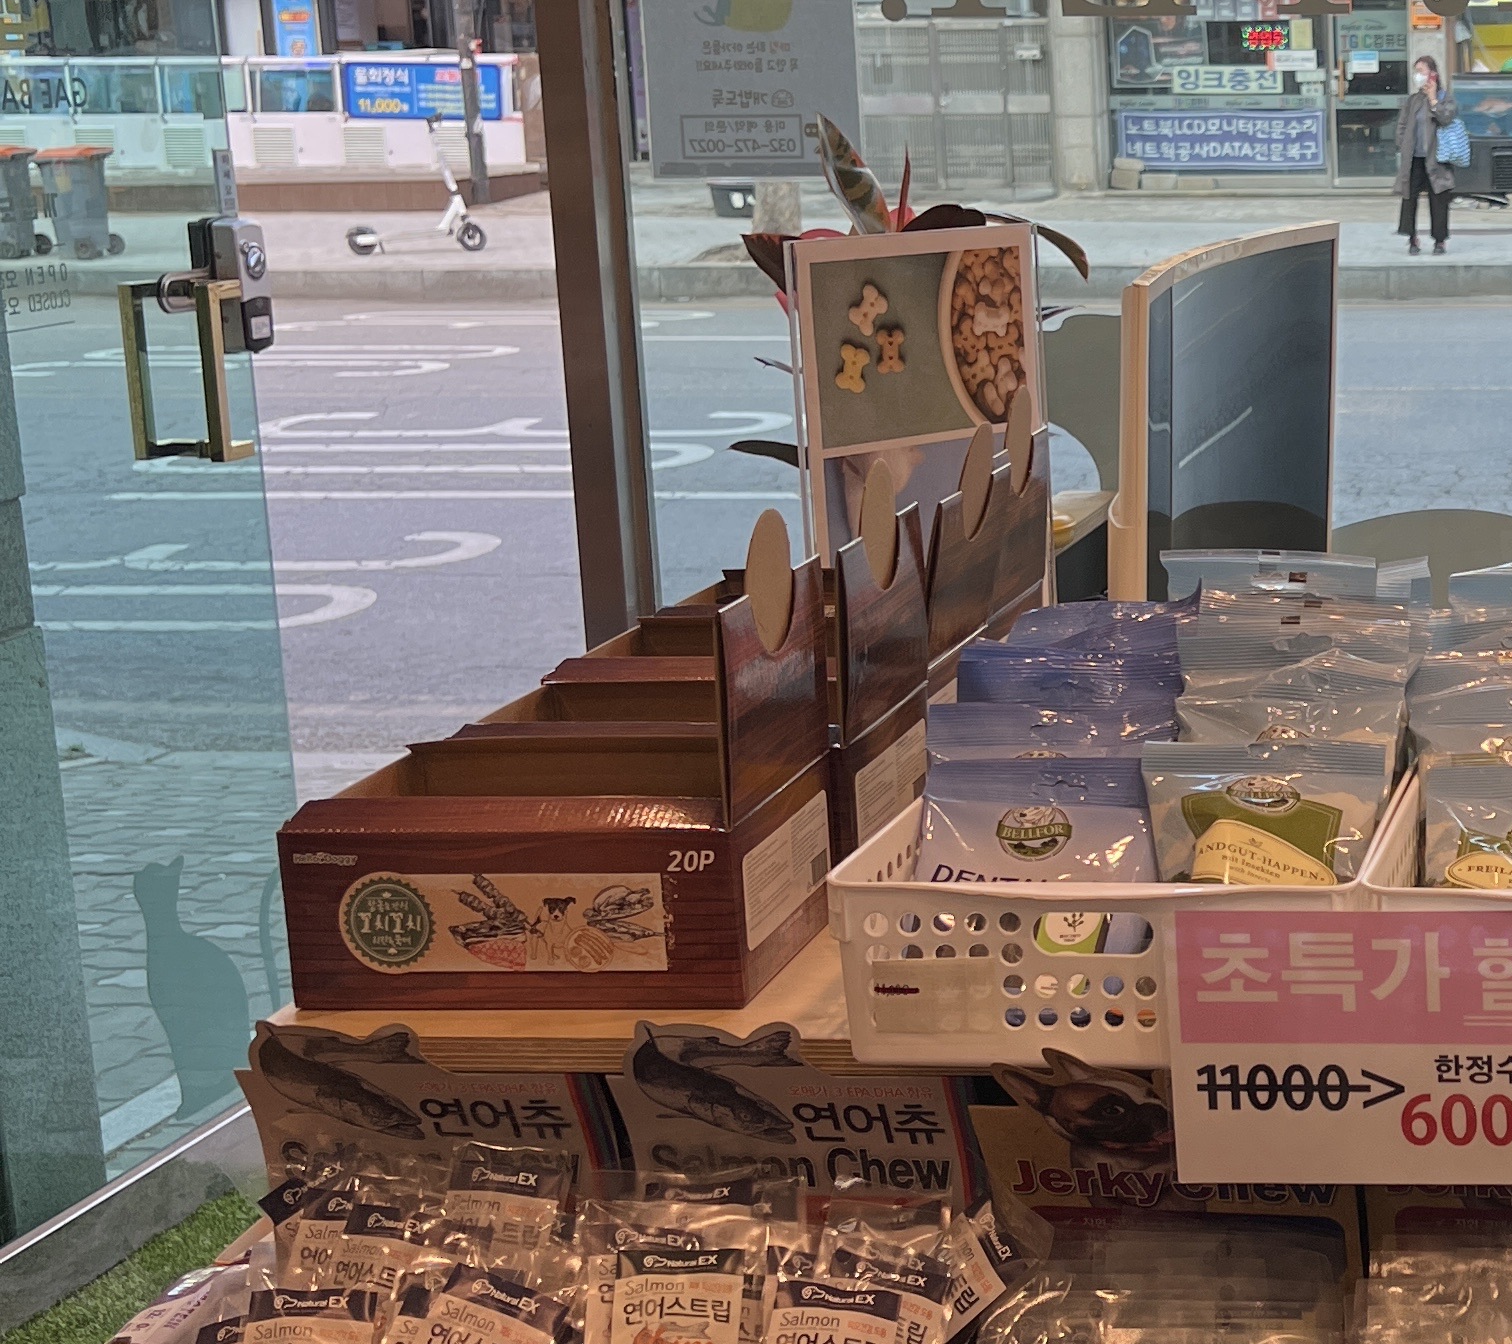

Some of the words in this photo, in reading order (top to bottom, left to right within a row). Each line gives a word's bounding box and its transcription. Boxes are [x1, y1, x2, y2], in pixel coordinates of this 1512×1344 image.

[1177, 69, 1280, 90] 잉크충전
[1002, 823, 1066, 842] BELLFOR
[666, 850, 716, 873] 20P
[1196, 932, 1451, 1014] 초특가
[419, 1096, 573, 1141] 연어츄
[791, 1101, 946, 1145] 연어츄
[624, 1277, 687, 1299] Salmon
[442, 1299, 496, 1333] Salmon
[623, 1297, 733, 1326] 연어스트립
[779, 1310, 842, 1330] Salmon
[253, 1321, 314, 1341] Salmon
